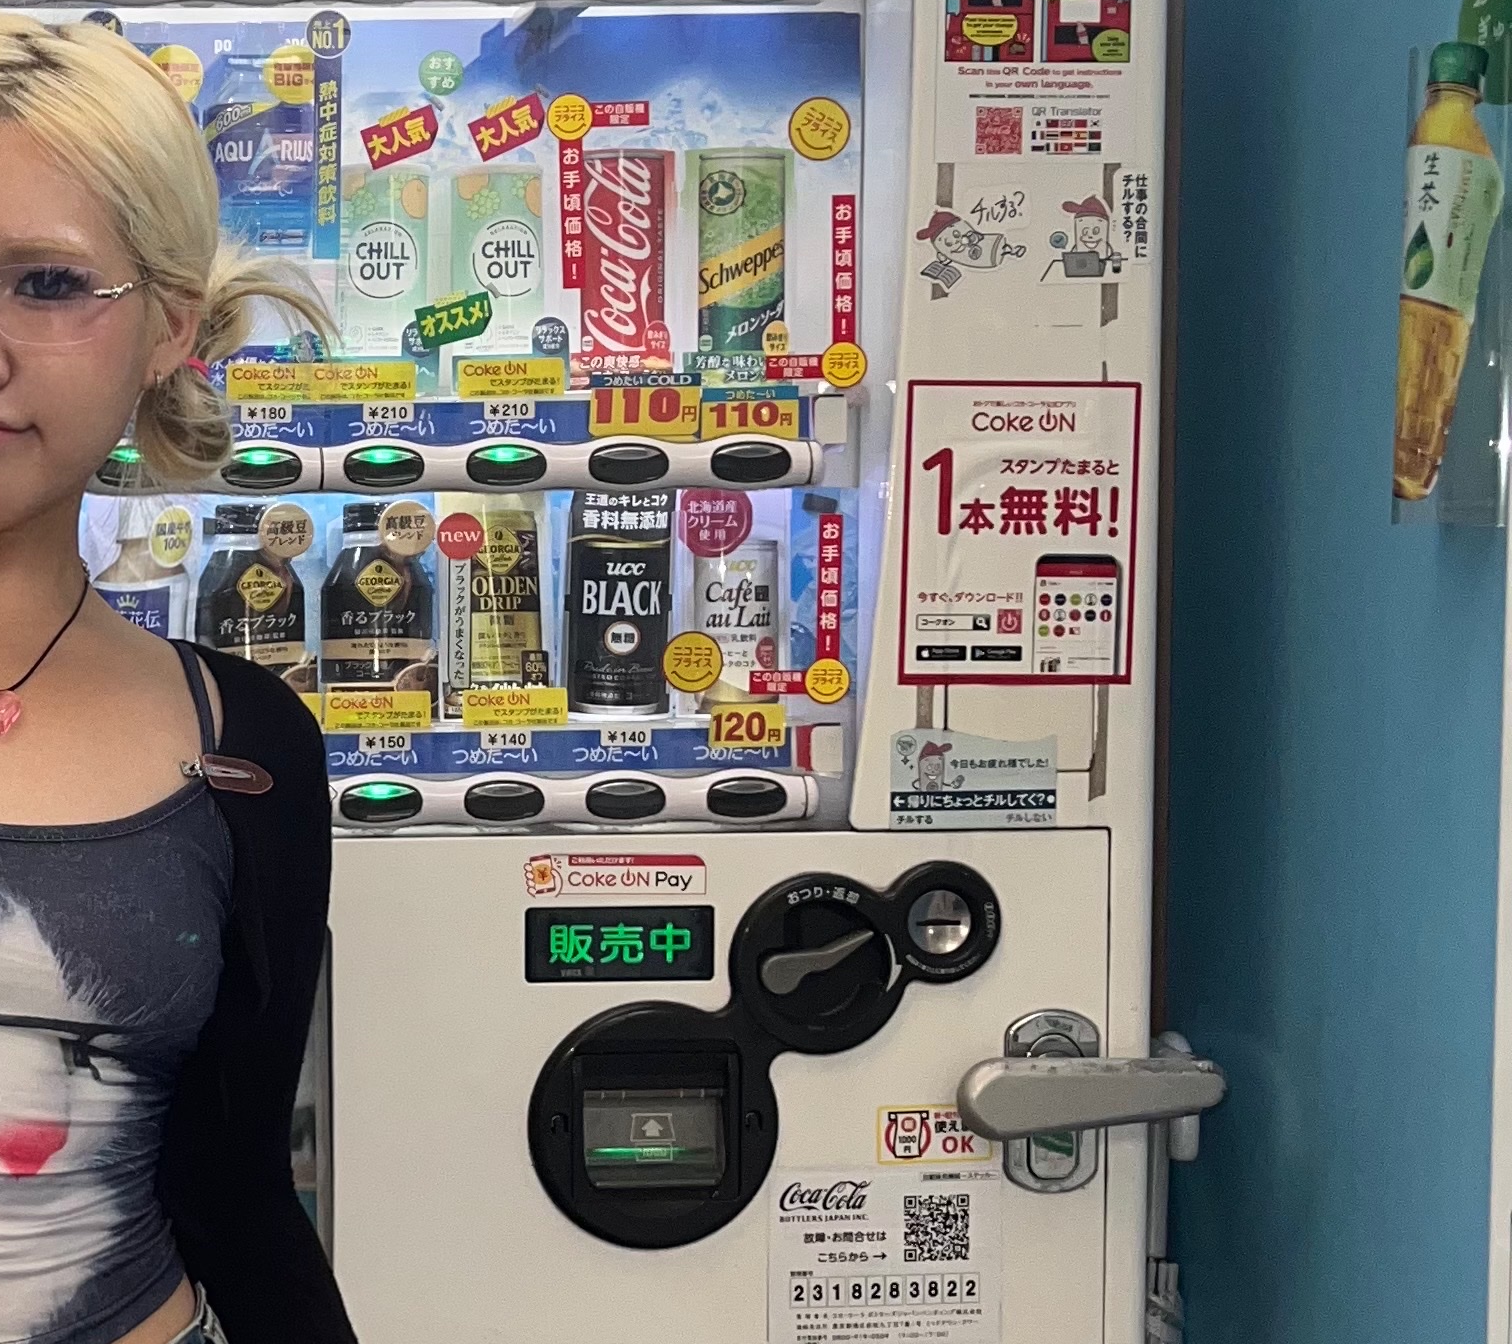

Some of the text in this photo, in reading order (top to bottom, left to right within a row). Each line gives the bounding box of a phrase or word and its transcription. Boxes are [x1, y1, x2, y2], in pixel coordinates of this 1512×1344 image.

[366, 115, 431, 160] 大人気
[474, 104, 539, 152] 大人気
[318, 82, 337, 225] 熱中症対策飲料
[1419, 153, 1440, 214] 生茶
[564, 148, 581, 280] お手頃価格!
[356, 242, 410, 261] CHILL
[481, 241, 535, 259] CHILL
[586, 156, 653, 353] Coca-Cola
[360, 261, 406, 280] OUT
[487, 260, 531, 279] OUT
[835, 203, 853, 334] お手頃価格!
[421, 300, 489, 334] オススメ!
[604, 373, 691, 386] つめたい COLD
[368, 406, 407, 419] ¥210
[596, 388, 697, 424] 110円
[709, 402, 793, 427] 110円
[1000, 460, 1119, 475] スタンプたまると
[585, 494, 668, 506] 王道のキレとコク
[922, 447, 1119, 537] 1本無料!
[688, 500, 736, 513] 北海道産
[583, 510, 666, 529] 香料無添加
[688, 515, 737, 527] クリーム
[267, 534, 305, 546] ブレンド
[441, 528, 481, 543] new
[699, 529, 725, 541] 使用
[240, 579, 283, 590] GEORGIA
[358, 577, 401, 587] GEORGIA
[582, 580, 661, 615] BLACK
[705, 582, 753, 603] Café
[479, 597, 522, 610] DRIP
[219, 613, 296, 634] 香るブラック
[342, 610, 415, 624] 香るブラック
[706, 604, 771, 627] au Lait
[611, 632, 635, 643] 無糖
[713, 714, 781, 743] 120円
[568, 868, 692, 891] Coke ON Pay
[549, 922, 690, 964] 販売中
[942, 1136, 974, 1153] OK
[818, 1253, 868, 1262] こちらから
